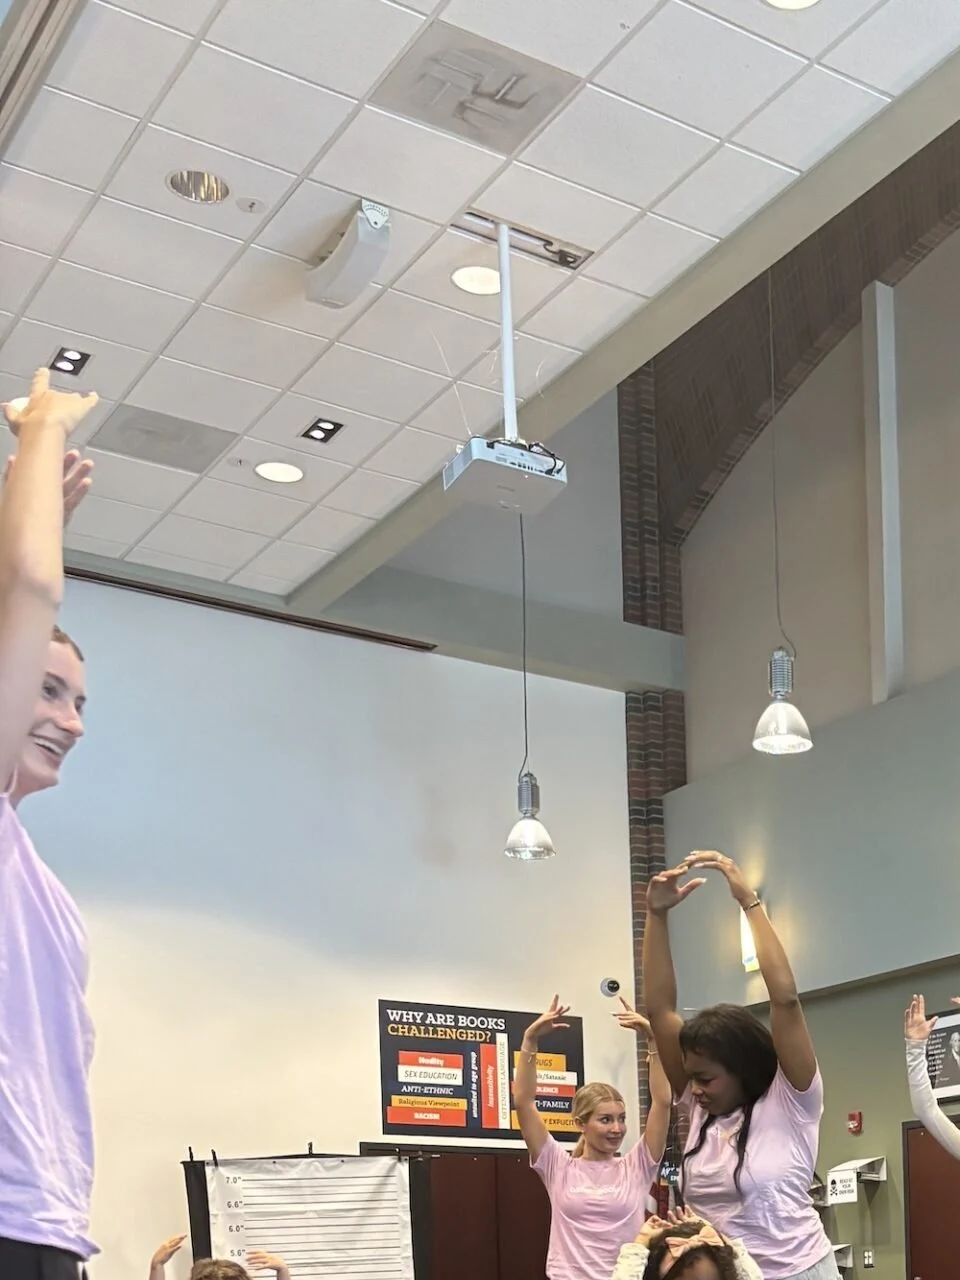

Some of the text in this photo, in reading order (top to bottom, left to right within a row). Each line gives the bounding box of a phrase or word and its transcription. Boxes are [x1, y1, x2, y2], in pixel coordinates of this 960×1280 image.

[386, 1009, 506, 1030] WHY ARE BOOKS
[387, 1023, 491, 1042] CHALLENGED?
[418, 1056, 445, 1067] Nudity
[470, 1051, 478, 1071] group
[404, 1070, 458, 1080] SEX EDUCATION
[401, 1085, 454, 1095] ANTI-ETHNIC
[398, 1098, 460, 1108] Religious Viewpoint
